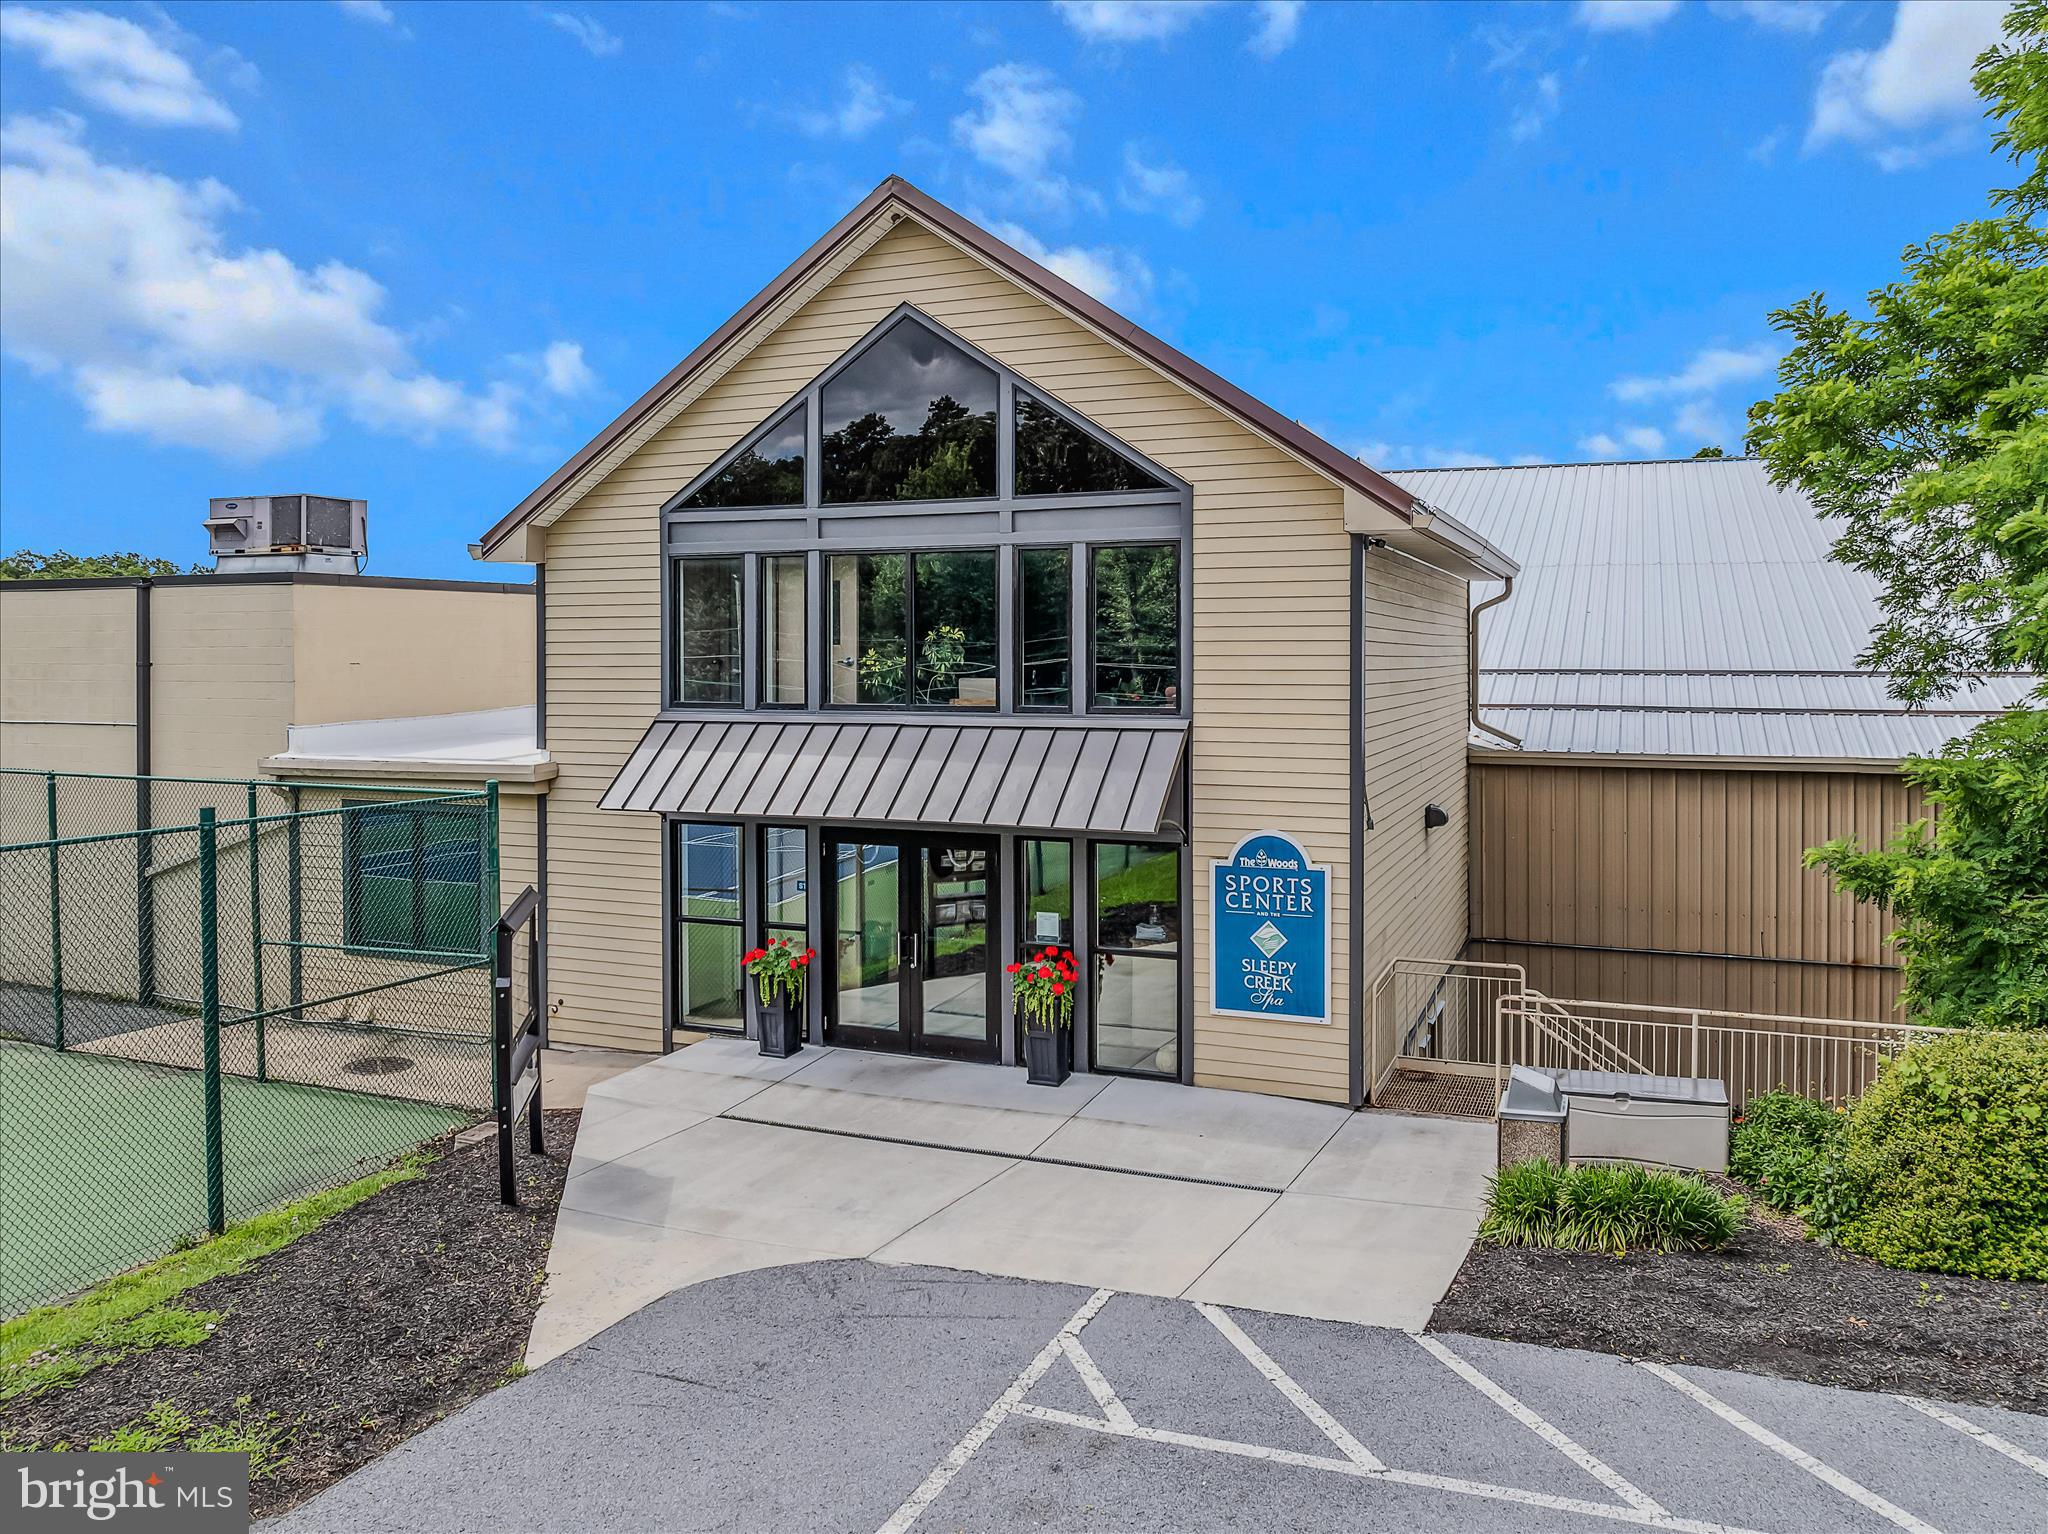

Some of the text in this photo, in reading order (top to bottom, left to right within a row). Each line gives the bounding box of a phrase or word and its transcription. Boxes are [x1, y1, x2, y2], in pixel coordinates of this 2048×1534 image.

[1239, 857, 1299, 868] The Woods
[1225, 874, 1312, 895] SPORTS
[1225, 891, 1314, 912] CENTER
[1241, 958, 1297, 976] SLEEPY
[1244, 974, 1294, 993] CREEK
[1250, 987, 1285, 1010] Spa
